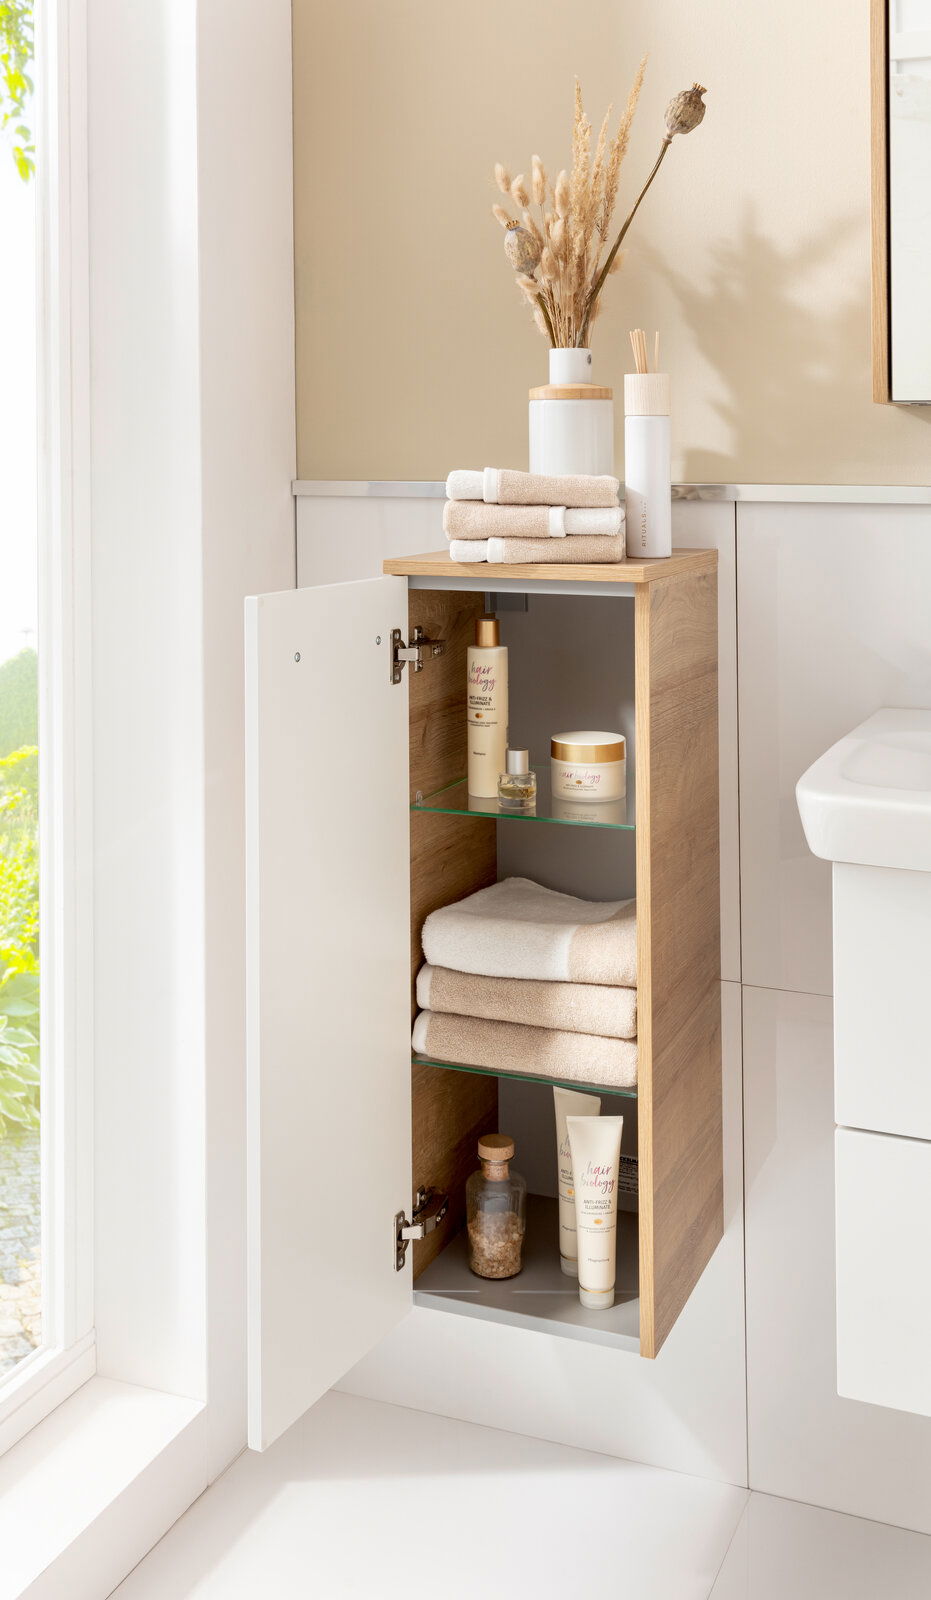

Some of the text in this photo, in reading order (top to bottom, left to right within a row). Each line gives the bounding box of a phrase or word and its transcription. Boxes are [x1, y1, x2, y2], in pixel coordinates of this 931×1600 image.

[471, 661, 493, 675] hair
[586, 1160, 612, 1175] hair
[581, 1172, 615, 1194] biology
